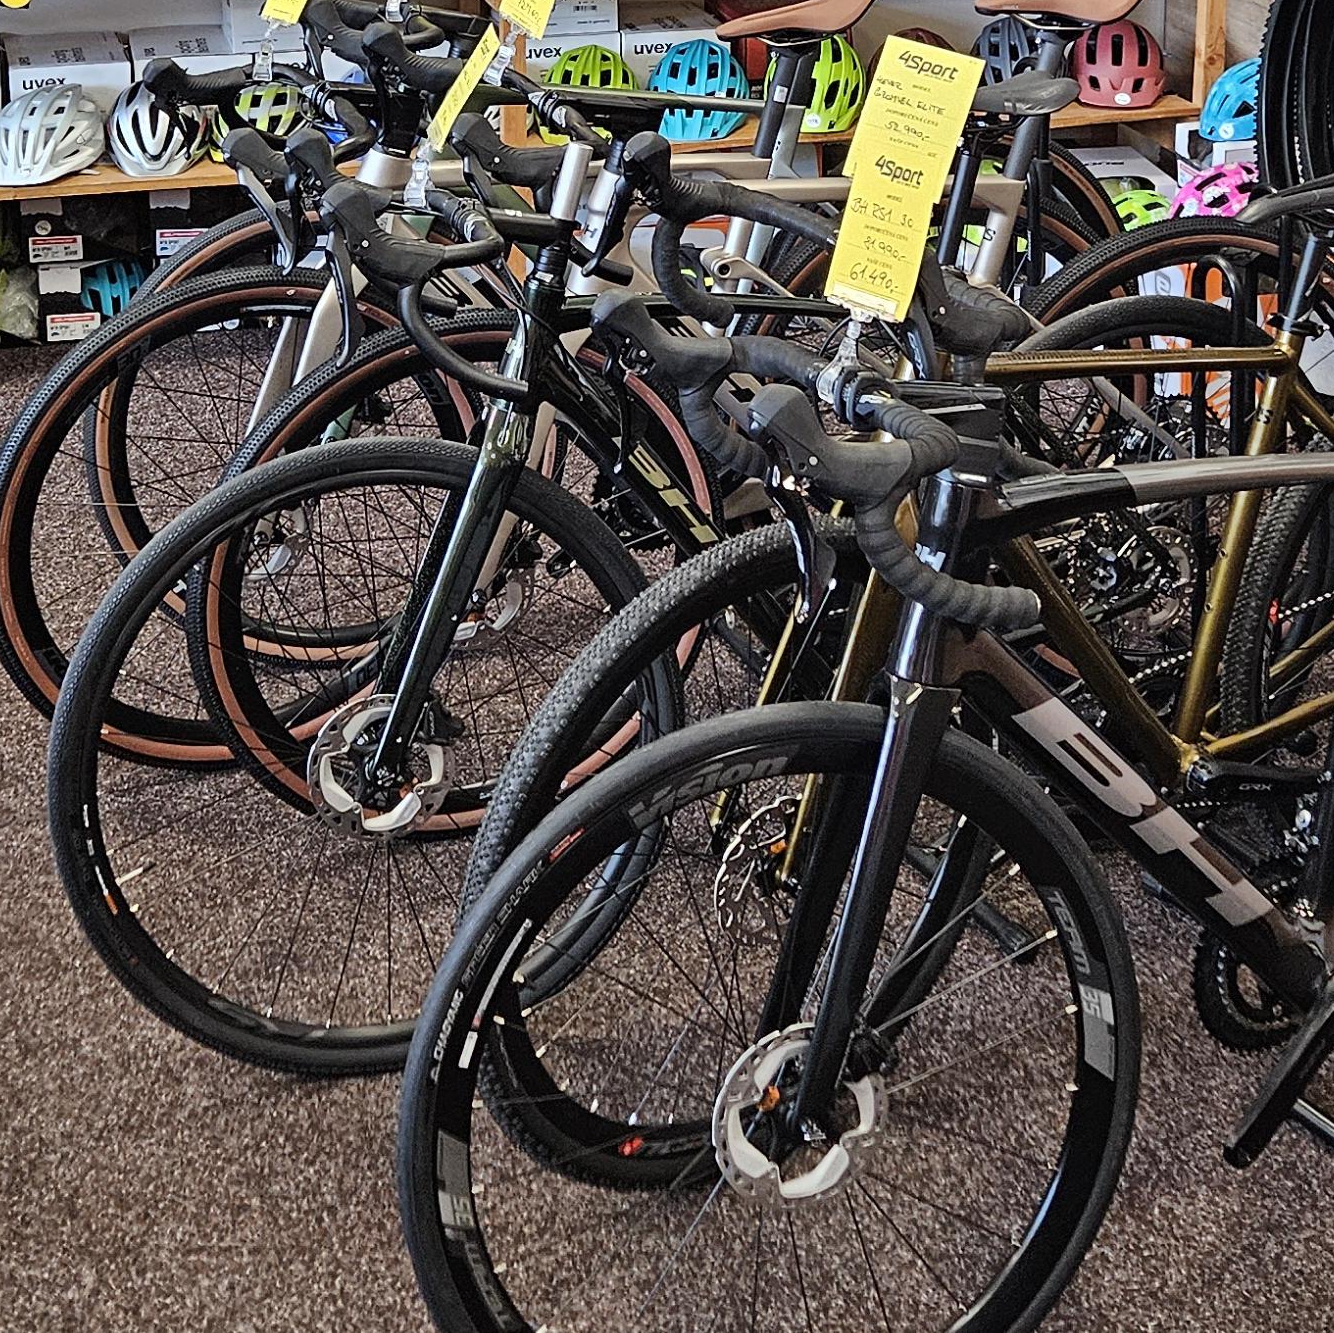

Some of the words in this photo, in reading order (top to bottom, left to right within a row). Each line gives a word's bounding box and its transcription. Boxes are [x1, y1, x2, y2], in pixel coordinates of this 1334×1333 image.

[633, 42, 673, 55] uvex
[898, 50, 959, 81] 4Sport
[22, 77, 67, 90] uvex
[874, 154, 924, 186] 4Sport
[628, 446, 720, 544] BH
[1238, 784, 1271, 792] GRX
[1012, 697, 1274, 927] BH
[1046, 889, 1091, 975] TEAM
[1083, 986, 1103, 1019] 35
[434, 989, 466, 1063] CHAOYANG
